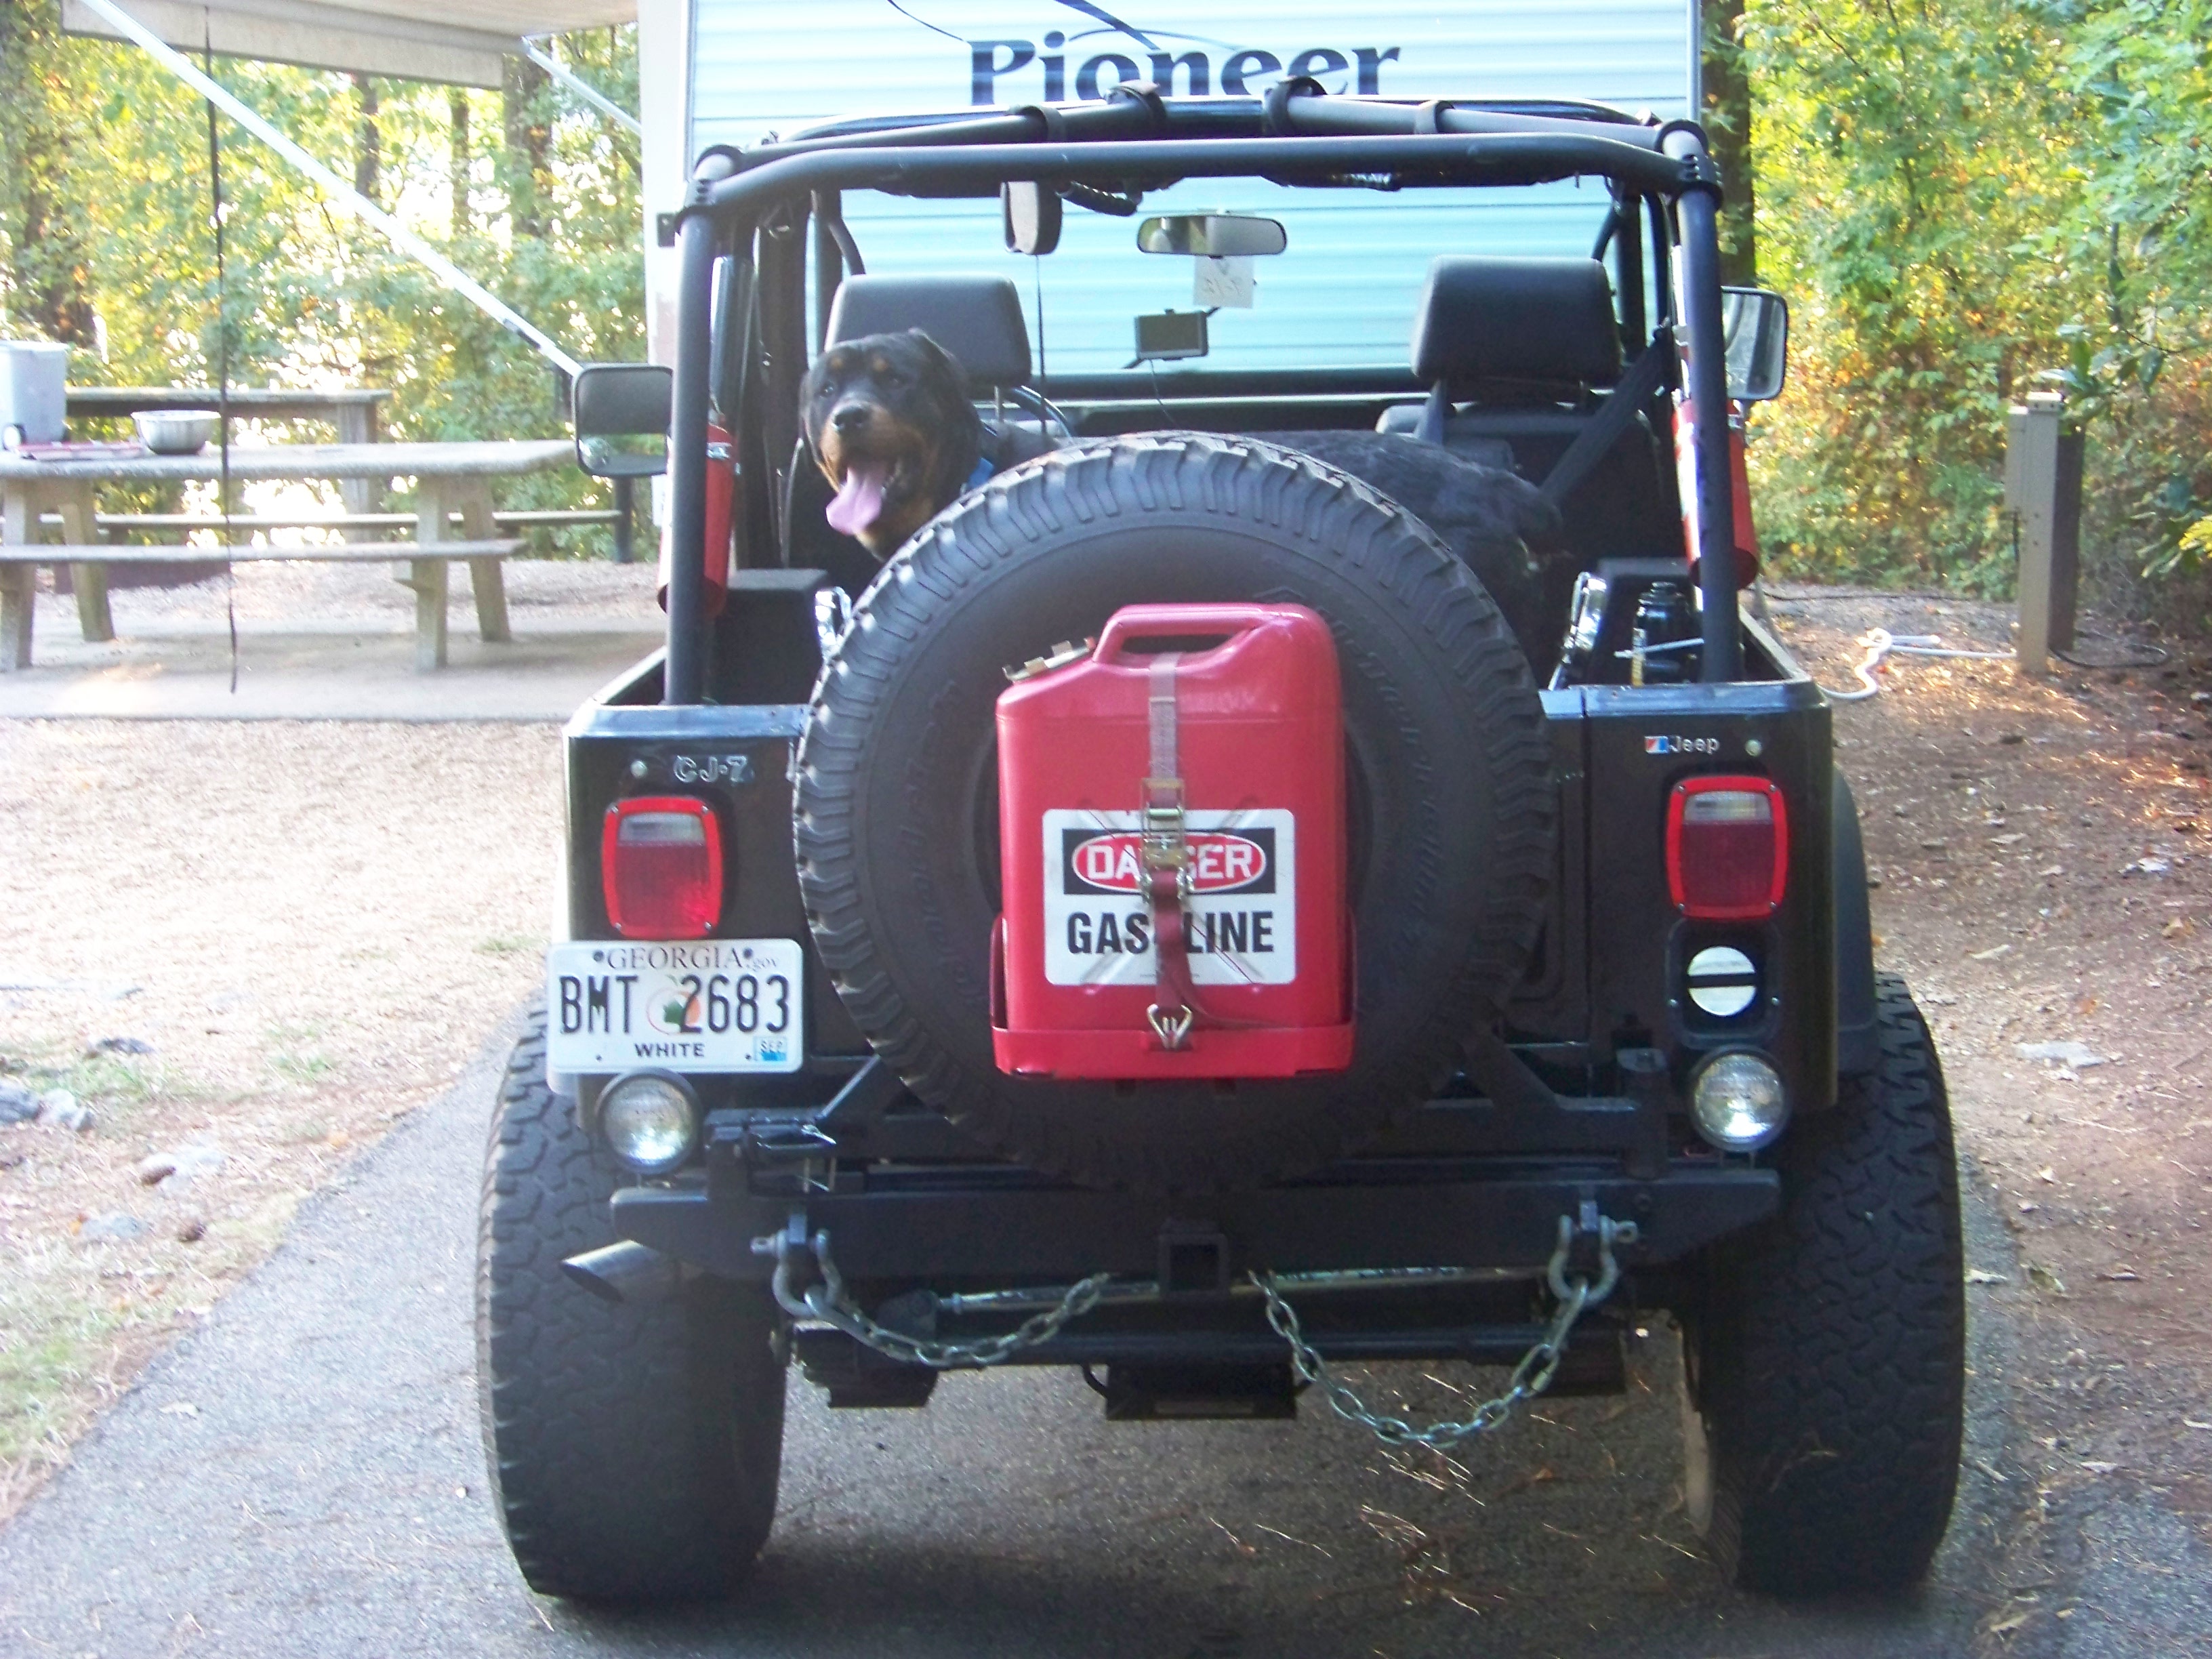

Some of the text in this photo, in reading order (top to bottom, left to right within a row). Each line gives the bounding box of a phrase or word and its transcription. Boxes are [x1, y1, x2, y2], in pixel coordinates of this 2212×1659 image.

[966, 30, 1401, 106] Pioneer
[1669, 736, 1719, 755] Jeep
[674, 755, 747, 784] CJ-7
[1086, 845, 1252, 879] DAER
[1067, 911, 1273, 954] GASLINE
[608, 947, 743, 969] GEORGIA
[560, 975, 789, 1033] BMT 2683
[635, 1042, 705, 1057] WHITE
